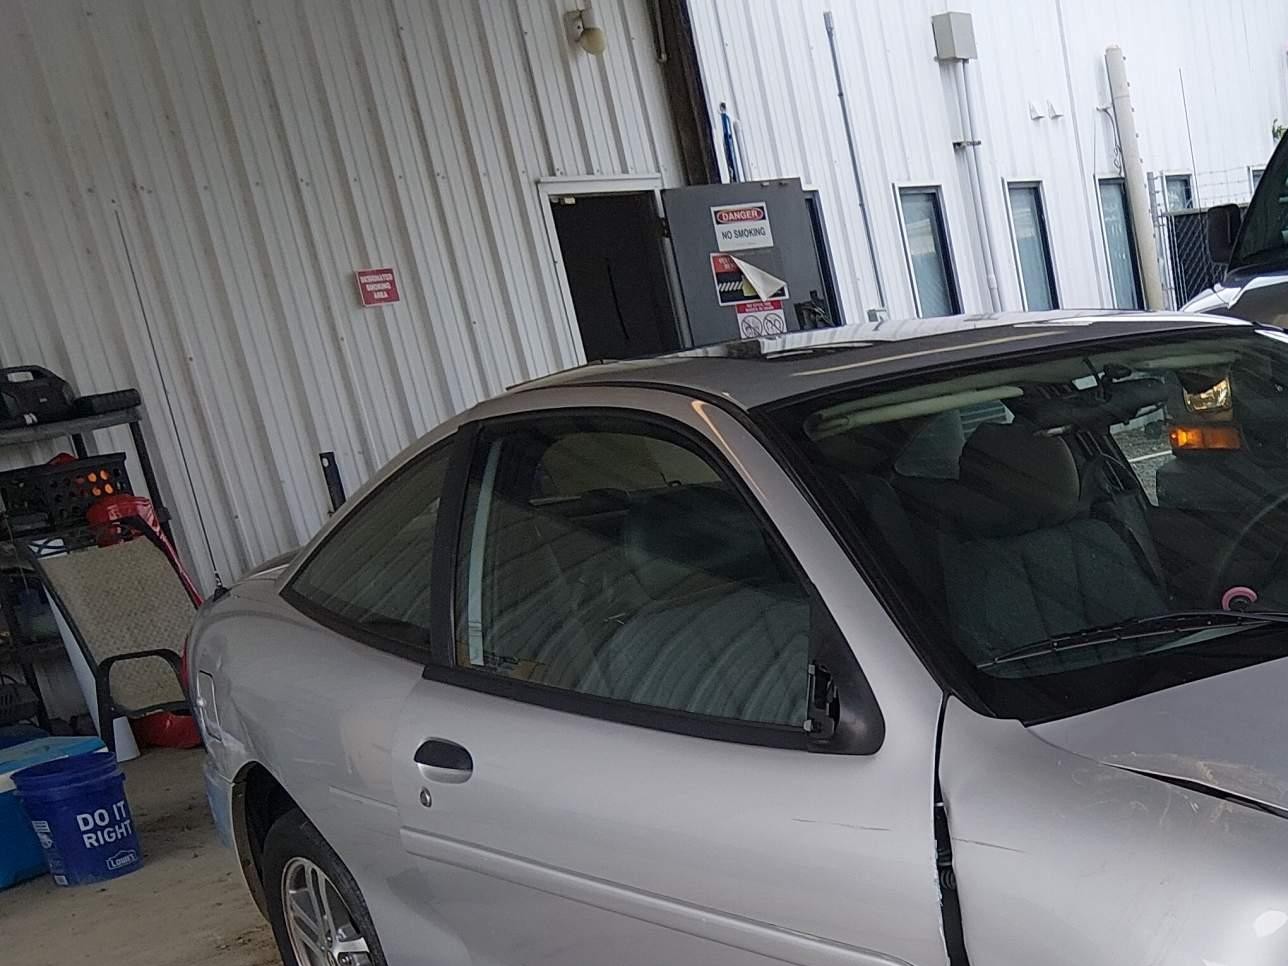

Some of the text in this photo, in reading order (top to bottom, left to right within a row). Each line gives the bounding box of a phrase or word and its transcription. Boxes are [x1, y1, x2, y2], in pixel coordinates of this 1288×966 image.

[721, 209, 758, 221] DANGER
[721, 226, 766, 240] NO SMOKING
[76, 800, 127, 832] DO IT
[82, 819, 133, 849] RIGHT
